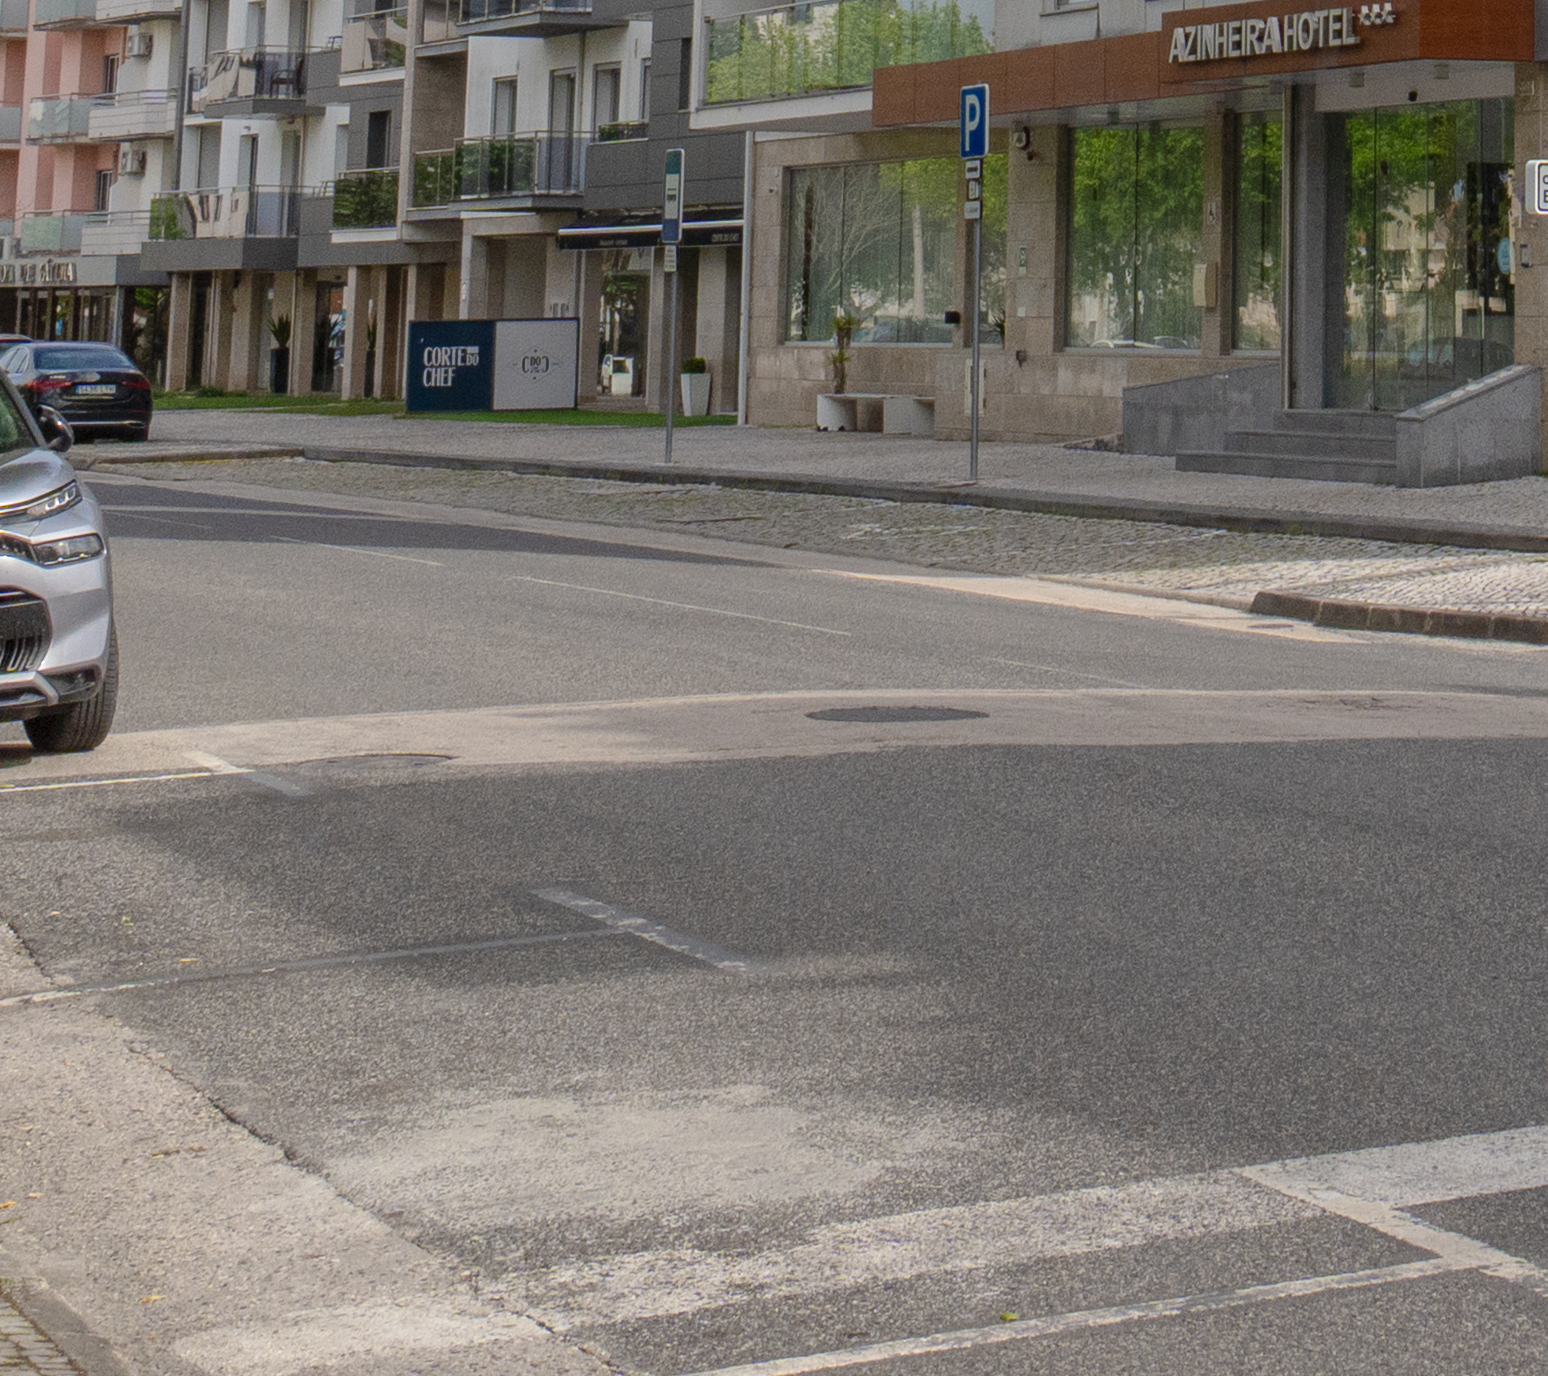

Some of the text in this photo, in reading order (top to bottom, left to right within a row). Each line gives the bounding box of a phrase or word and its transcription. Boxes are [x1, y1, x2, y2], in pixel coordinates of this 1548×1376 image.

[964, 94, 981, 152] P
[423, 347, 480, 367] CORTE DO
[422, 367, 457, 387] CHEF
